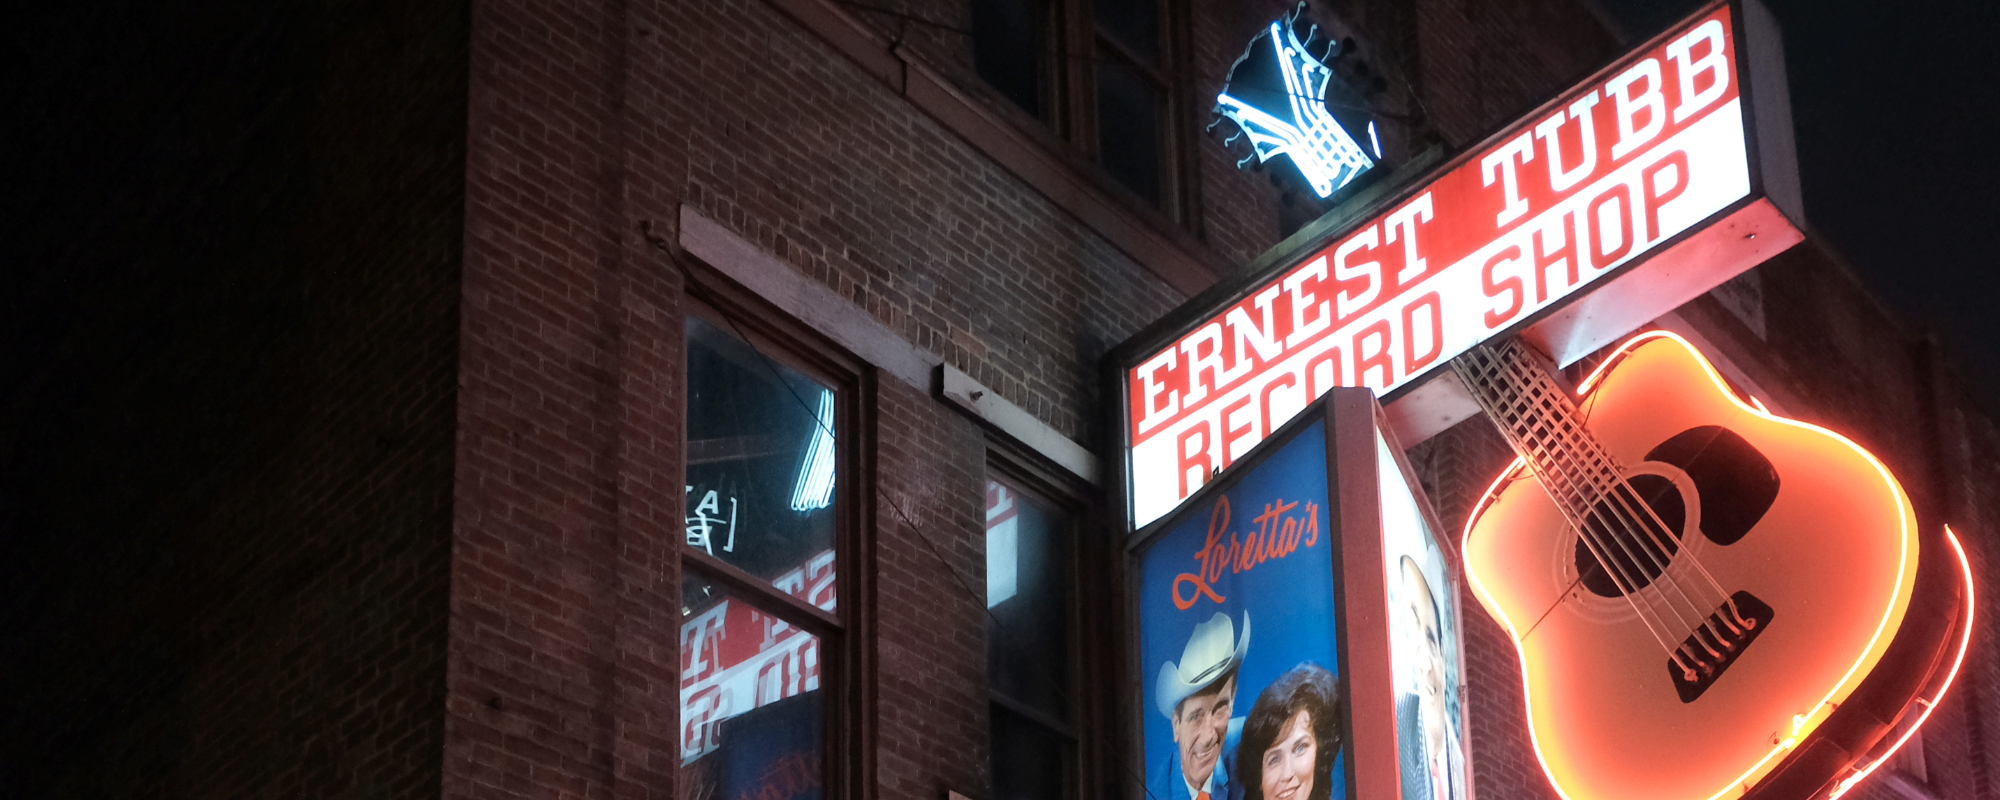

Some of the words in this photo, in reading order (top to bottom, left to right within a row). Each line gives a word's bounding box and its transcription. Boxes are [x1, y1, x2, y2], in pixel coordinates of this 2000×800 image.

[1138, 192, 1433, 436] ERNEST
[1482, 19, 1729, 229] TUBB
[1480, 149, 1690, 330] SHOP
[1172, 494, 1319, 610] Loretta's
